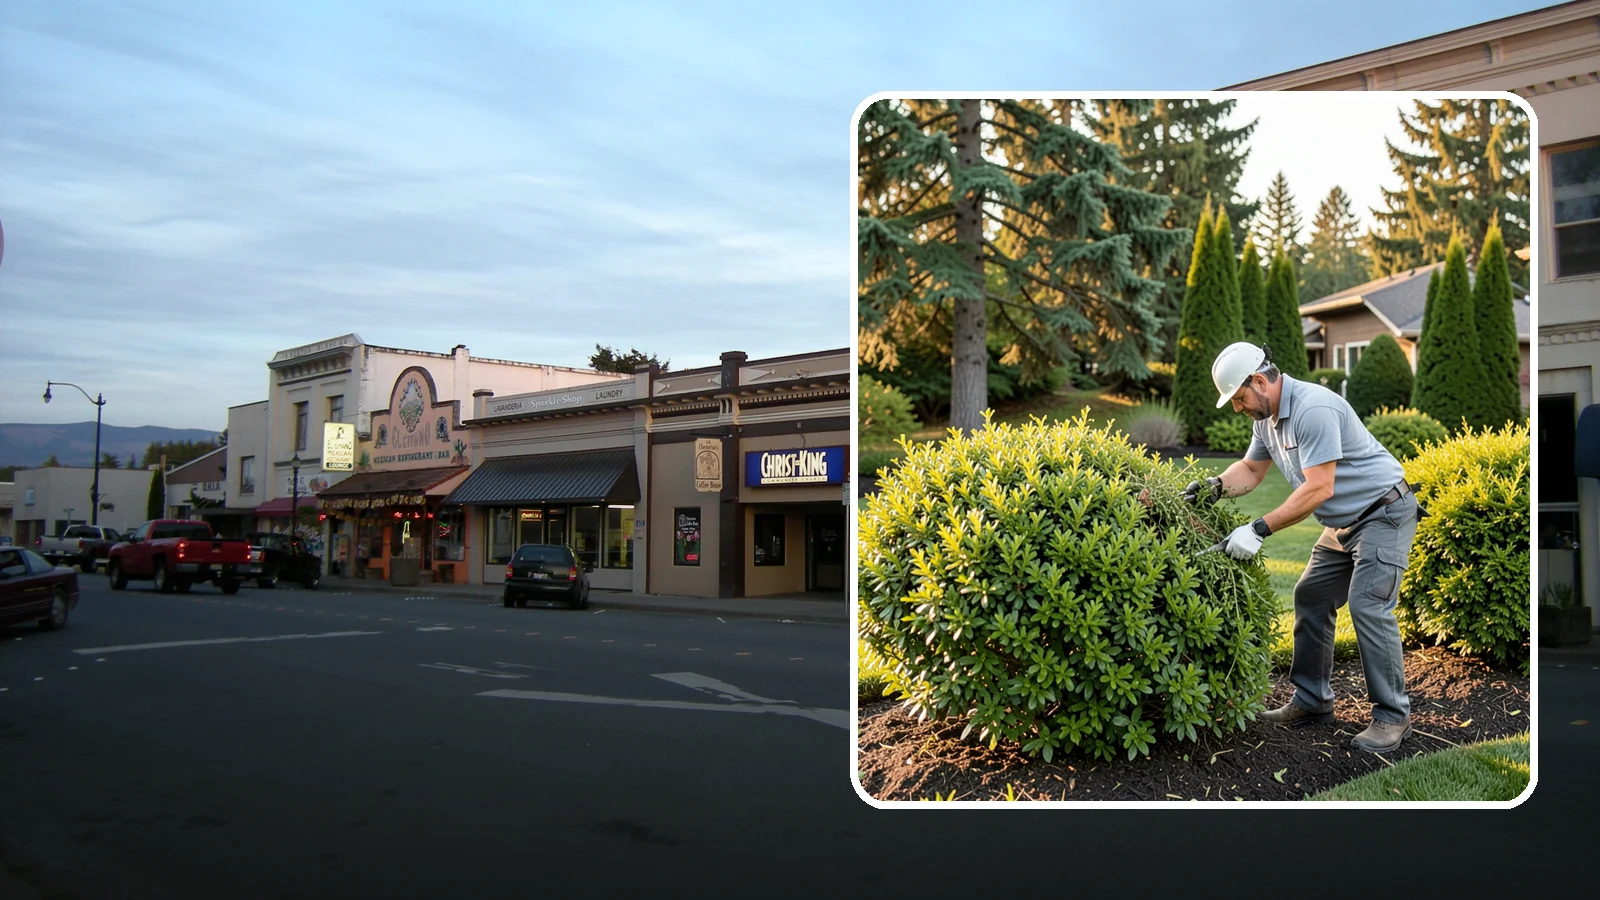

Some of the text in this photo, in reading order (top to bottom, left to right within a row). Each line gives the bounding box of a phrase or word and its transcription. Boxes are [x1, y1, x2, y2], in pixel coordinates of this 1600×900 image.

[561, 394, 583, 404] Shop
[595, 389, 624, 400] LAUNDRY
[493, 402, 523, 412] LAVANDERIA
[373, 450, 450, 464] MEXICAN RESTAURANT BAR
[761, 450, 827, 478] CHRIST KING
